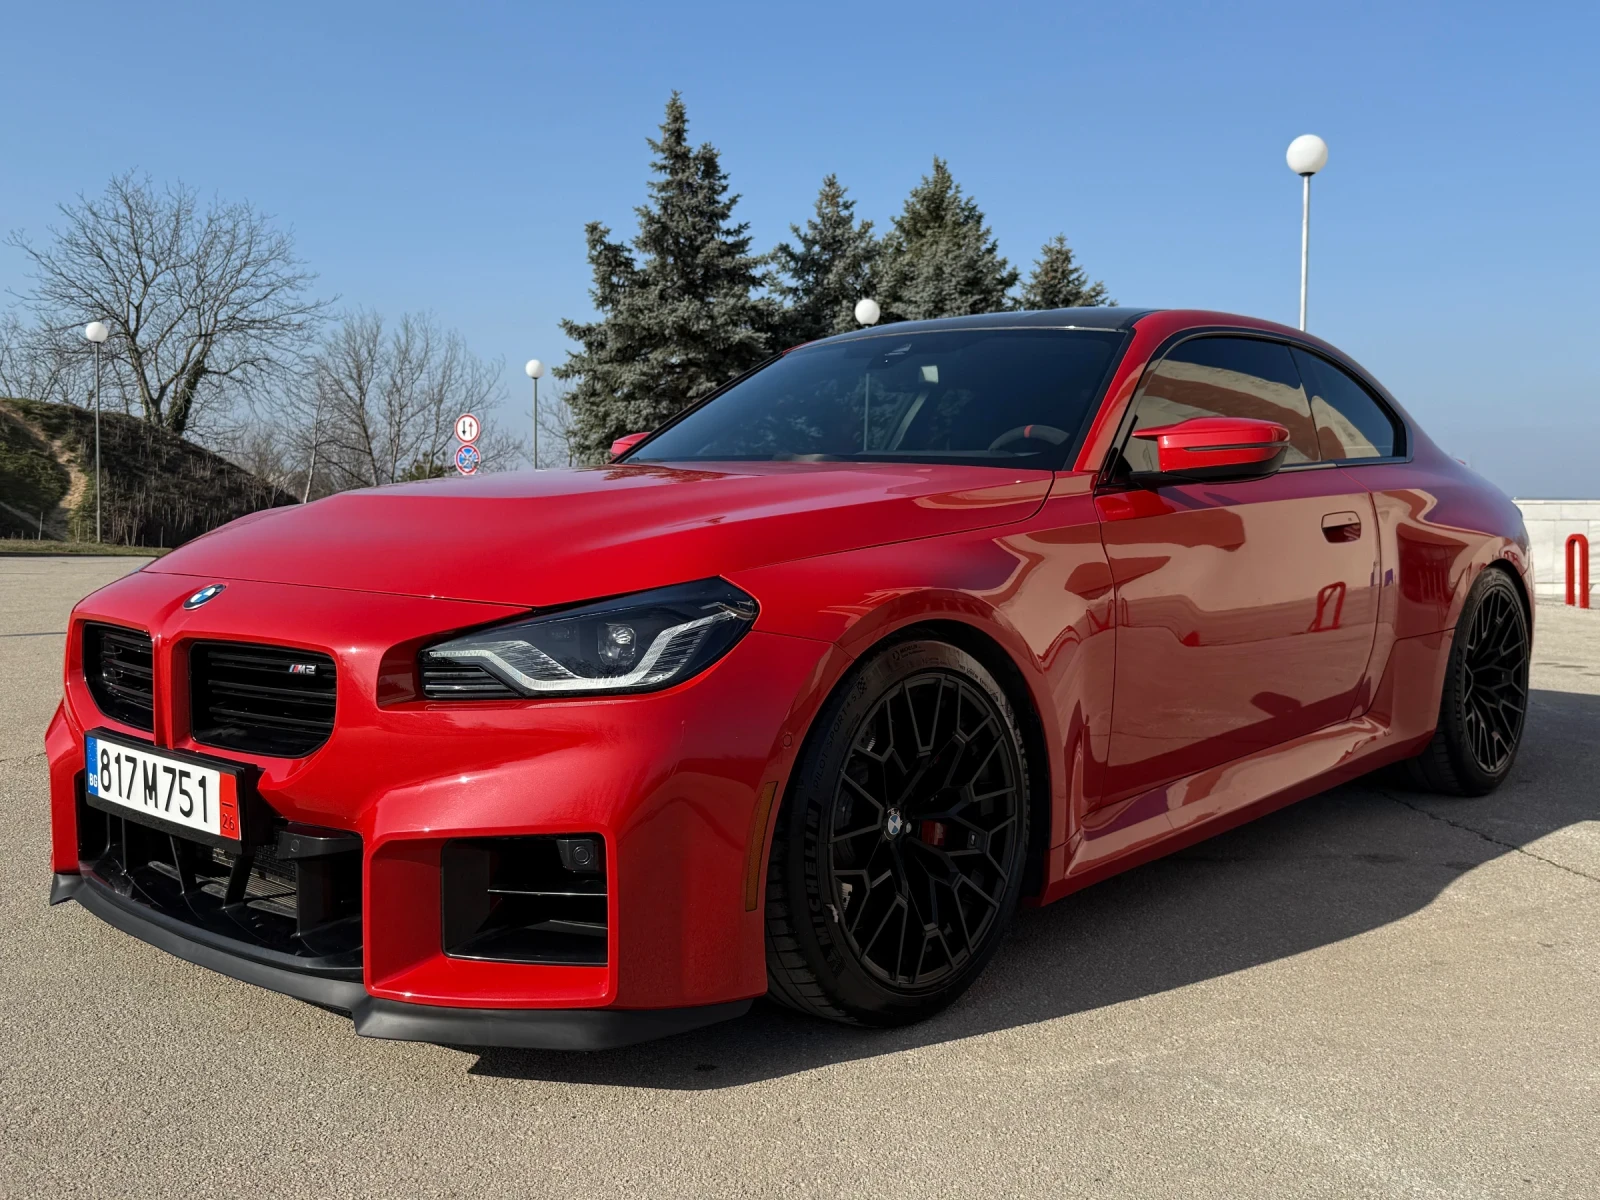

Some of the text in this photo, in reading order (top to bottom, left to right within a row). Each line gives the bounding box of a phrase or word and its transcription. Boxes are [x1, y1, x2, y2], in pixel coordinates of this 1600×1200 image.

[827, 708, 848, 747] SPORT
[89, 773, 98, 787] BG
[222, 813, 235, 831] 26
[804, 808, 832, 945] MICHELIN
